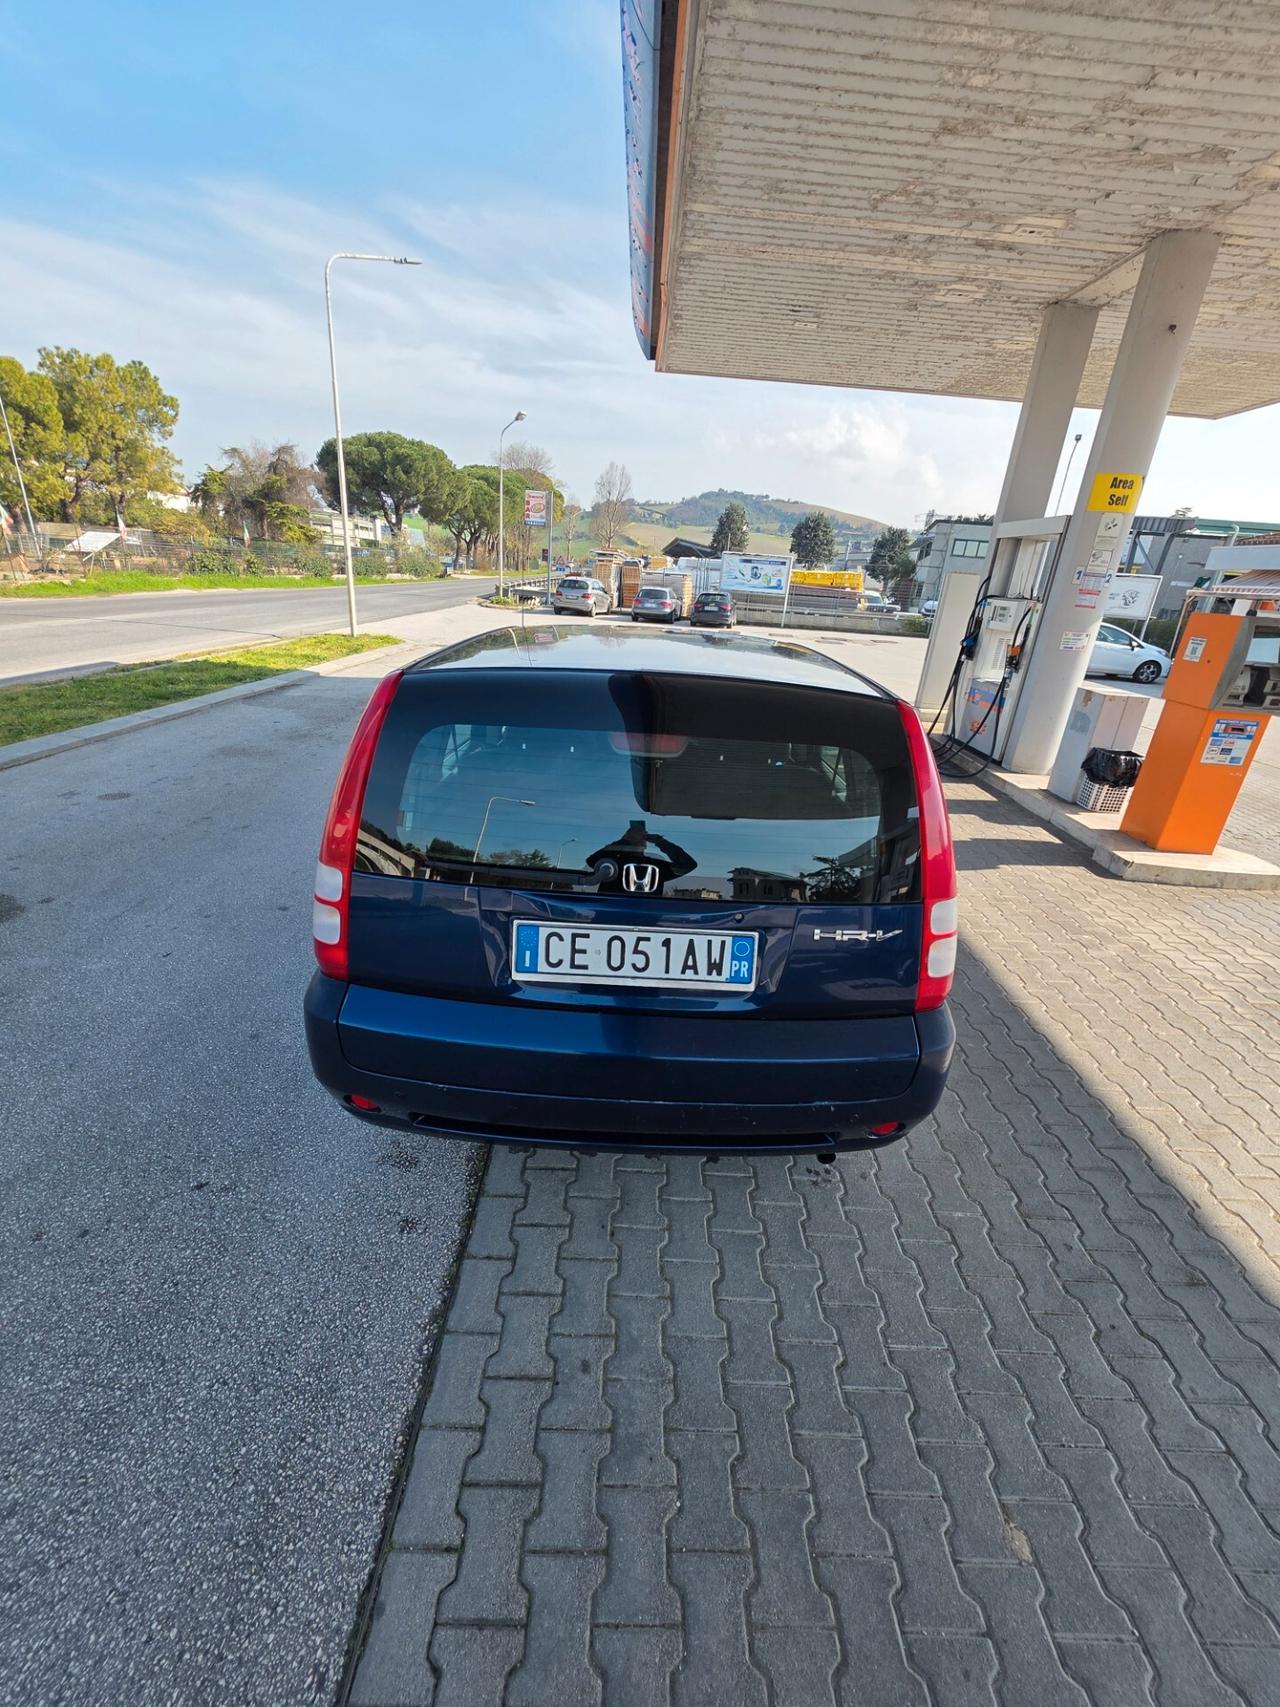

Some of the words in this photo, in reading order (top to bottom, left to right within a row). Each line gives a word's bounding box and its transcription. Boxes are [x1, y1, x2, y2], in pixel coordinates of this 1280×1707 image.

[1110, 477, 1135, 490] Area
[1108, 493, 1130, 507] Self
[1076, 570, 1083, 580] 1
[1104, 573, 1112, 584] 2
[813, 928, 903, 942] HR-V
[544, 931, 591, 971] CE
[606, 934, 727, 977] 051AW
[730, 960, 749, 978] PR
